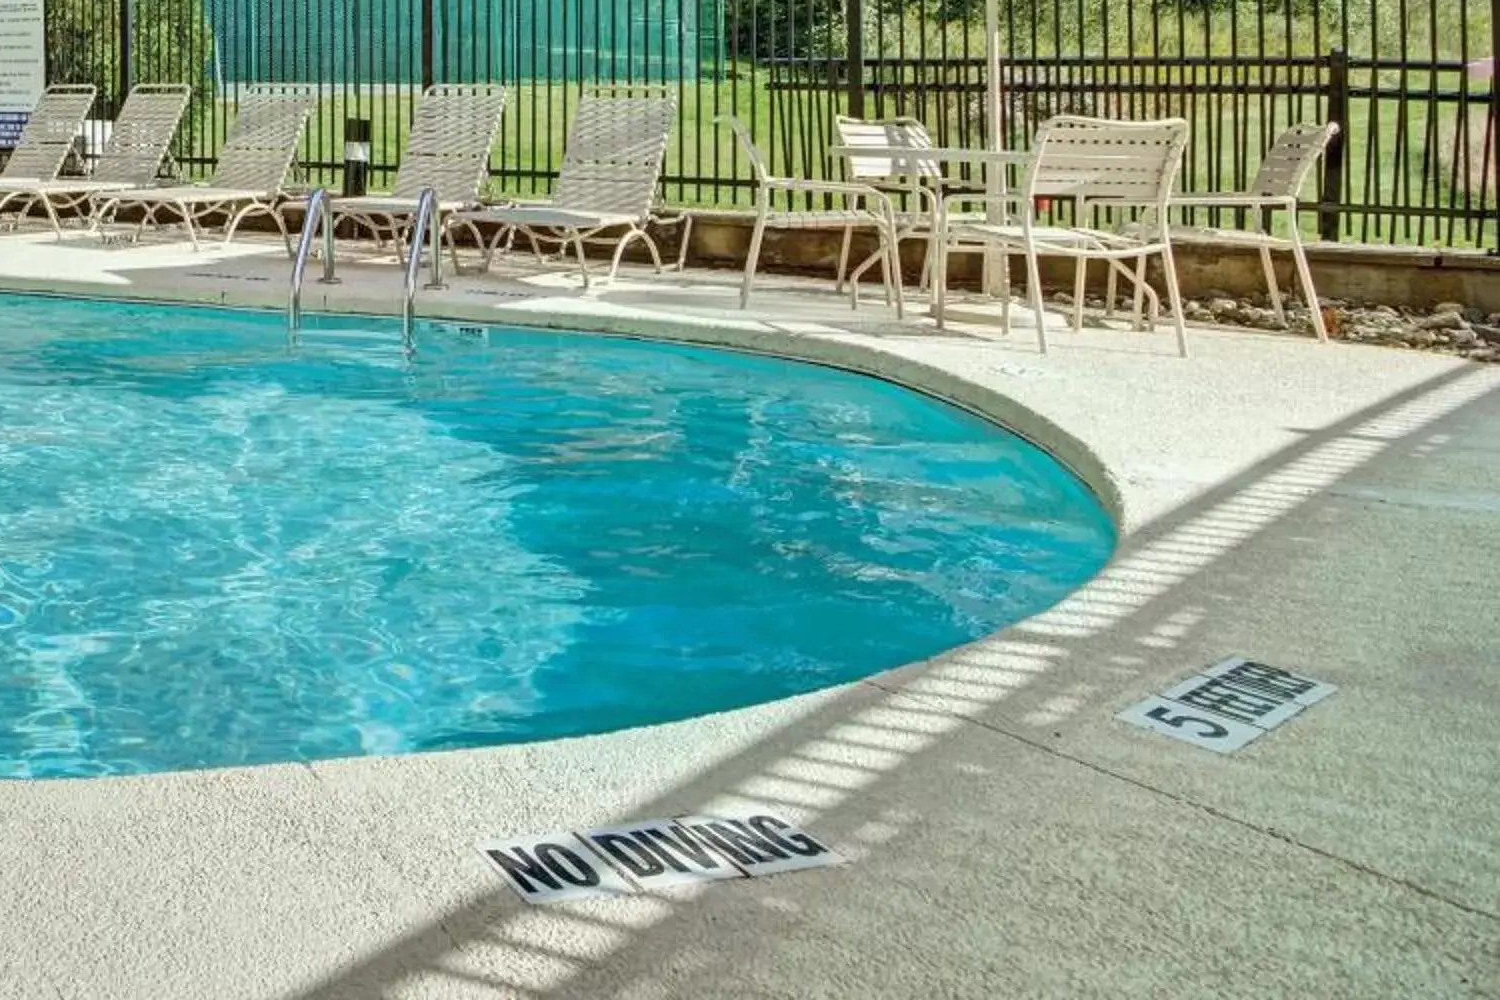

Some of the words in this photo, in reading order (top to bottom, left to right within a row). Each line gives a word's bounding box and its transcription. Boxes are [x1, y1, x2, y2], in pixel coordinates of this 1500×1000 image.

[1145, 706, 1229, 738] 5
[486, 842, 601, 893] NO
[590, 814, 829, 877] DIVING
